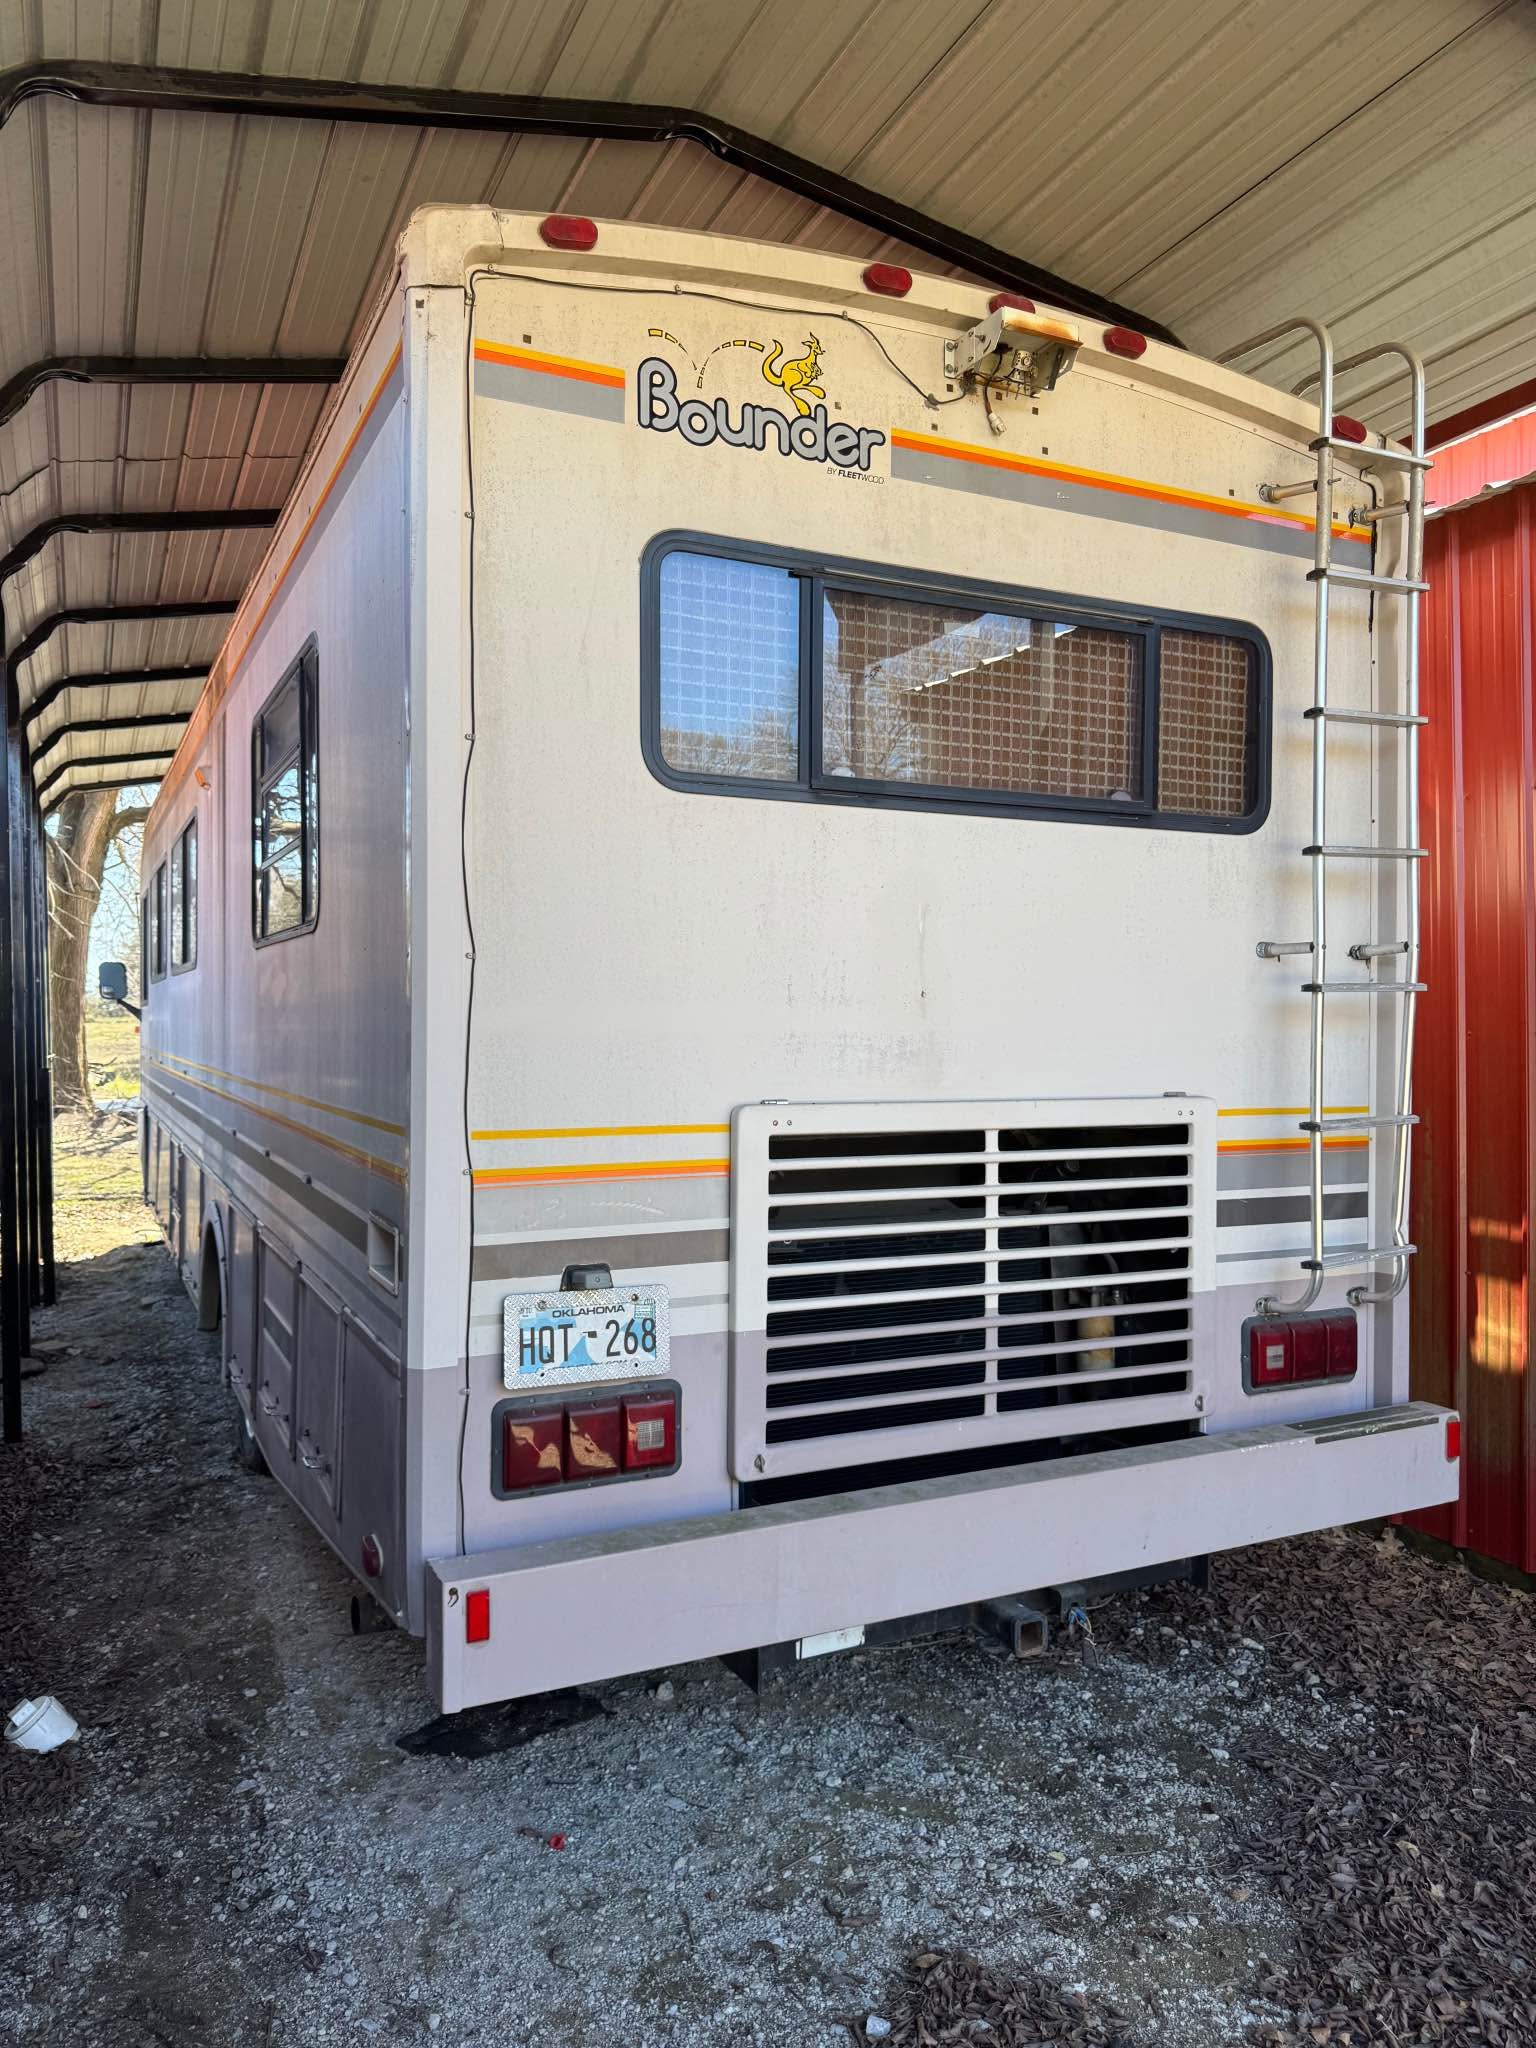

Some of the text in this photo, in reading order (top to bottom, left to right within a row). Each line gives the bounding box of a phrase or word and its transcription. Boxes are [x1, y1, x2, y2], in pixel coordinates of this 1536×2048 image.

[637, 356, 886, 471] Bounder
[826, 467, 885, 485] BY FLEETWOOD
[552, 1304, 626, 1318] OKLAHOMA
[519, 1317, 657, 1367] HQT 268
